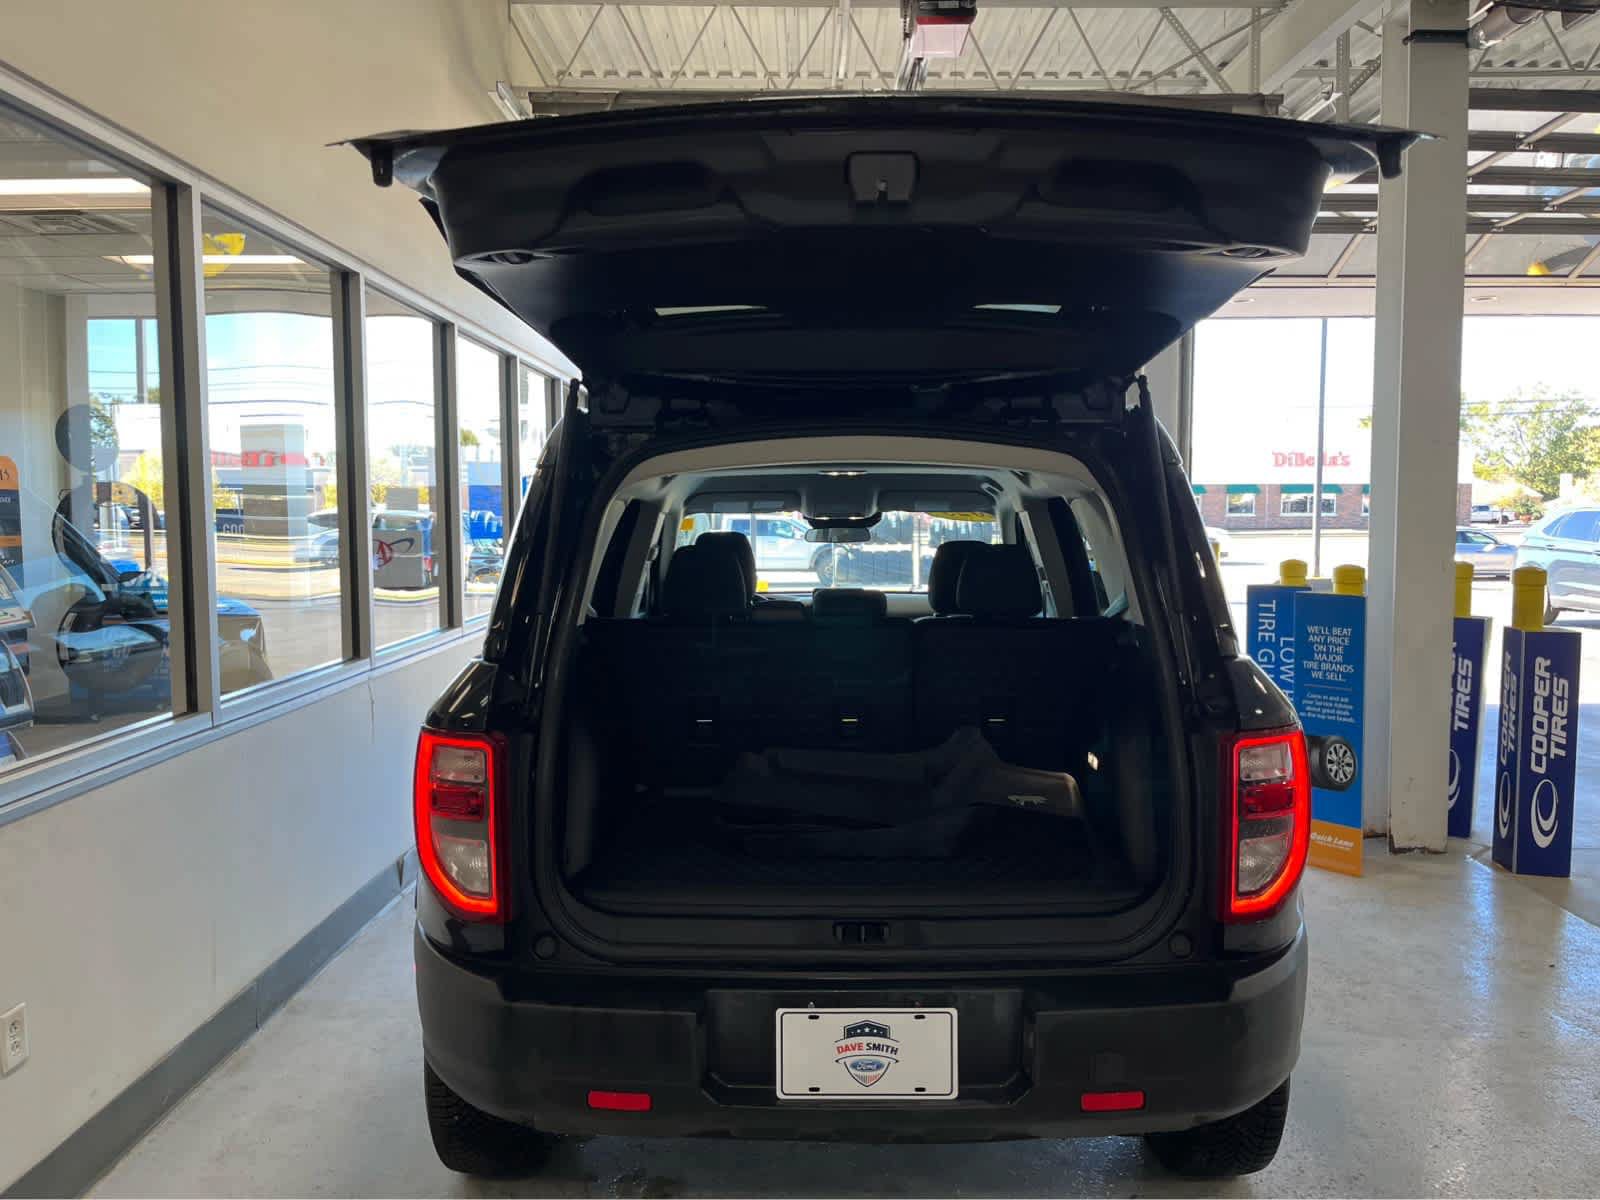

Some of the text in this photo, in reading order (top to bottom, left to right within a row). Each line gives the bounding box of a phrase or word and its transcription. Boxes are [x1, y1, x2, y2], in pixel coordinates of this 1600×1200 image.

[1272, 451, 1350, 467] DiBela's
[1257, 600, 1276, 642] TIRE
[1307, 625, 1352, 636] WE'LL BEAT
[1308, 635, 1350, 646] ANY PRICE
[1313, 645, 1344, 654] ON THE
[1279, 637, 1295, 684] LOW
[1314, 654, 1343, 663] MAJOR
[1303, 661, 1354, 673] TIRE BRANDS
[1311, 671, 1323, 679] WE
[1454, 656, 1473, 732] TIRES
[1530, 655, 1552, 774] COOPER
[1550, 676, 1569, 760] TIRES
[836, 1042, 899, 1055] DAVE SMITH
[856, 1061, 878, 1071] Ford
